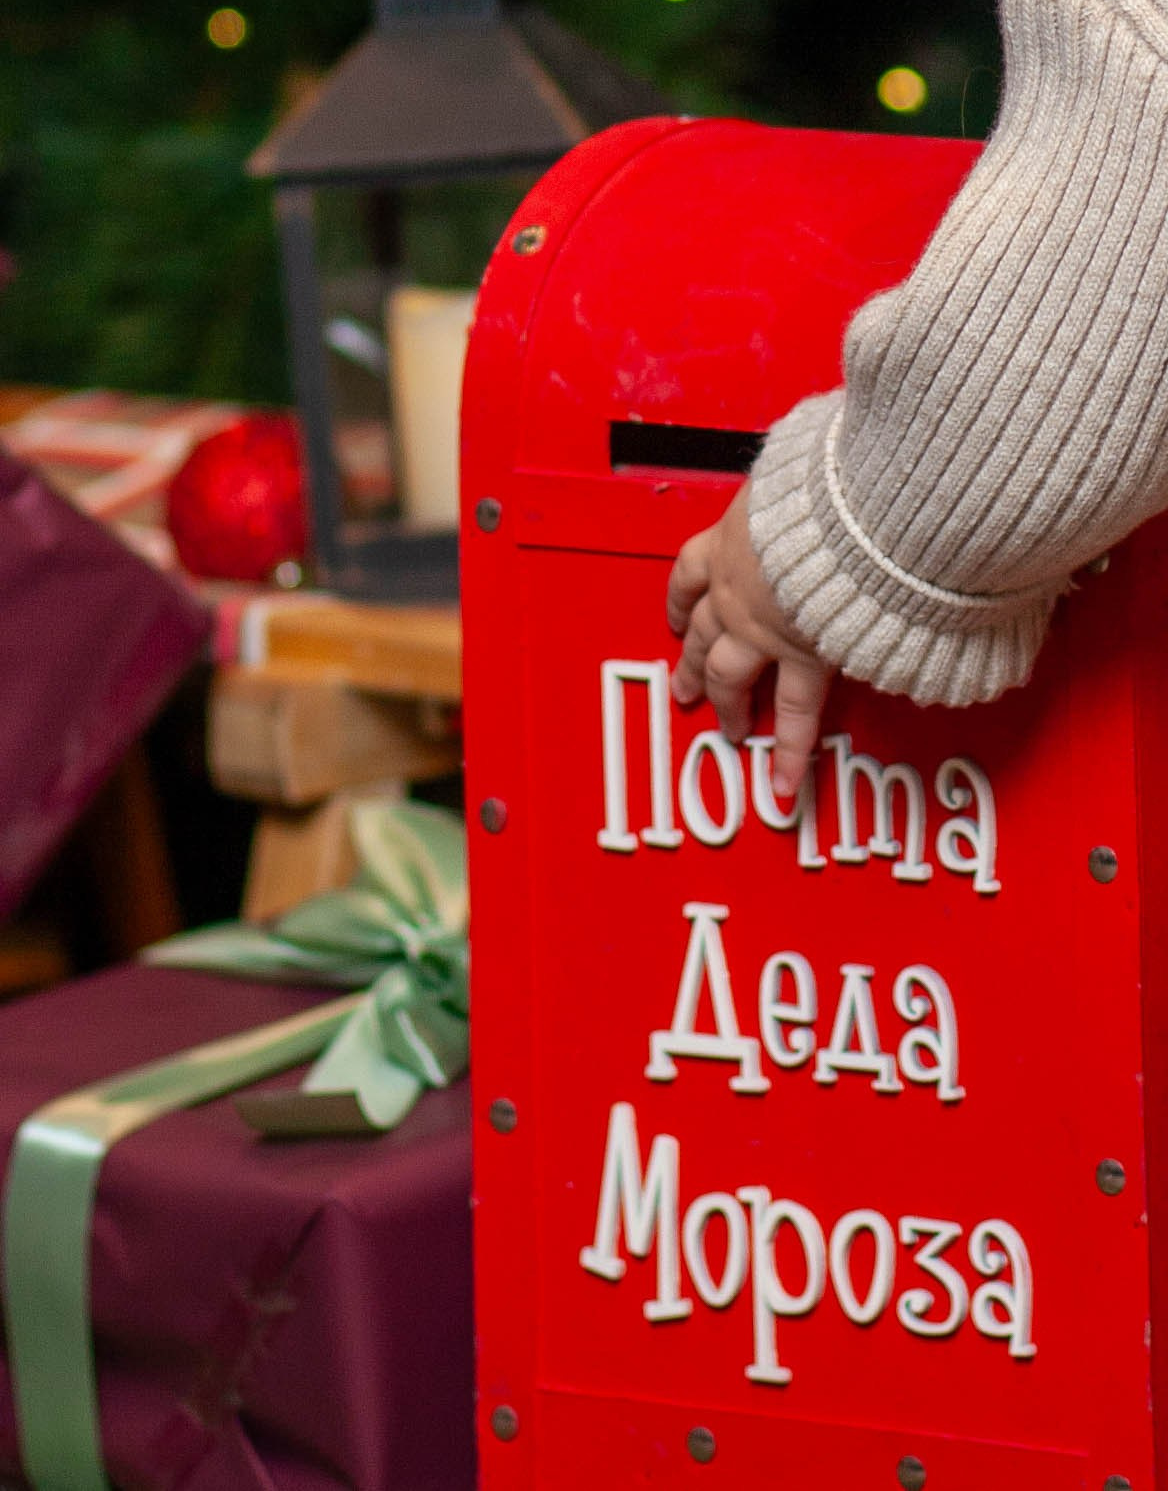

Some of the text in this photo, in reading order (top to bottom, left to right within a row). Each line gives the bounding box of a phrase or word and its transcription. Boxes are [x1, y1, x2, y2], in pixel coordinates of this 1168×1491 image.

[598, 659, 1001, 893] Почта
[645, 901, 966, 1101] Деда
[580, 1101, 1037, 1383] Мороза
